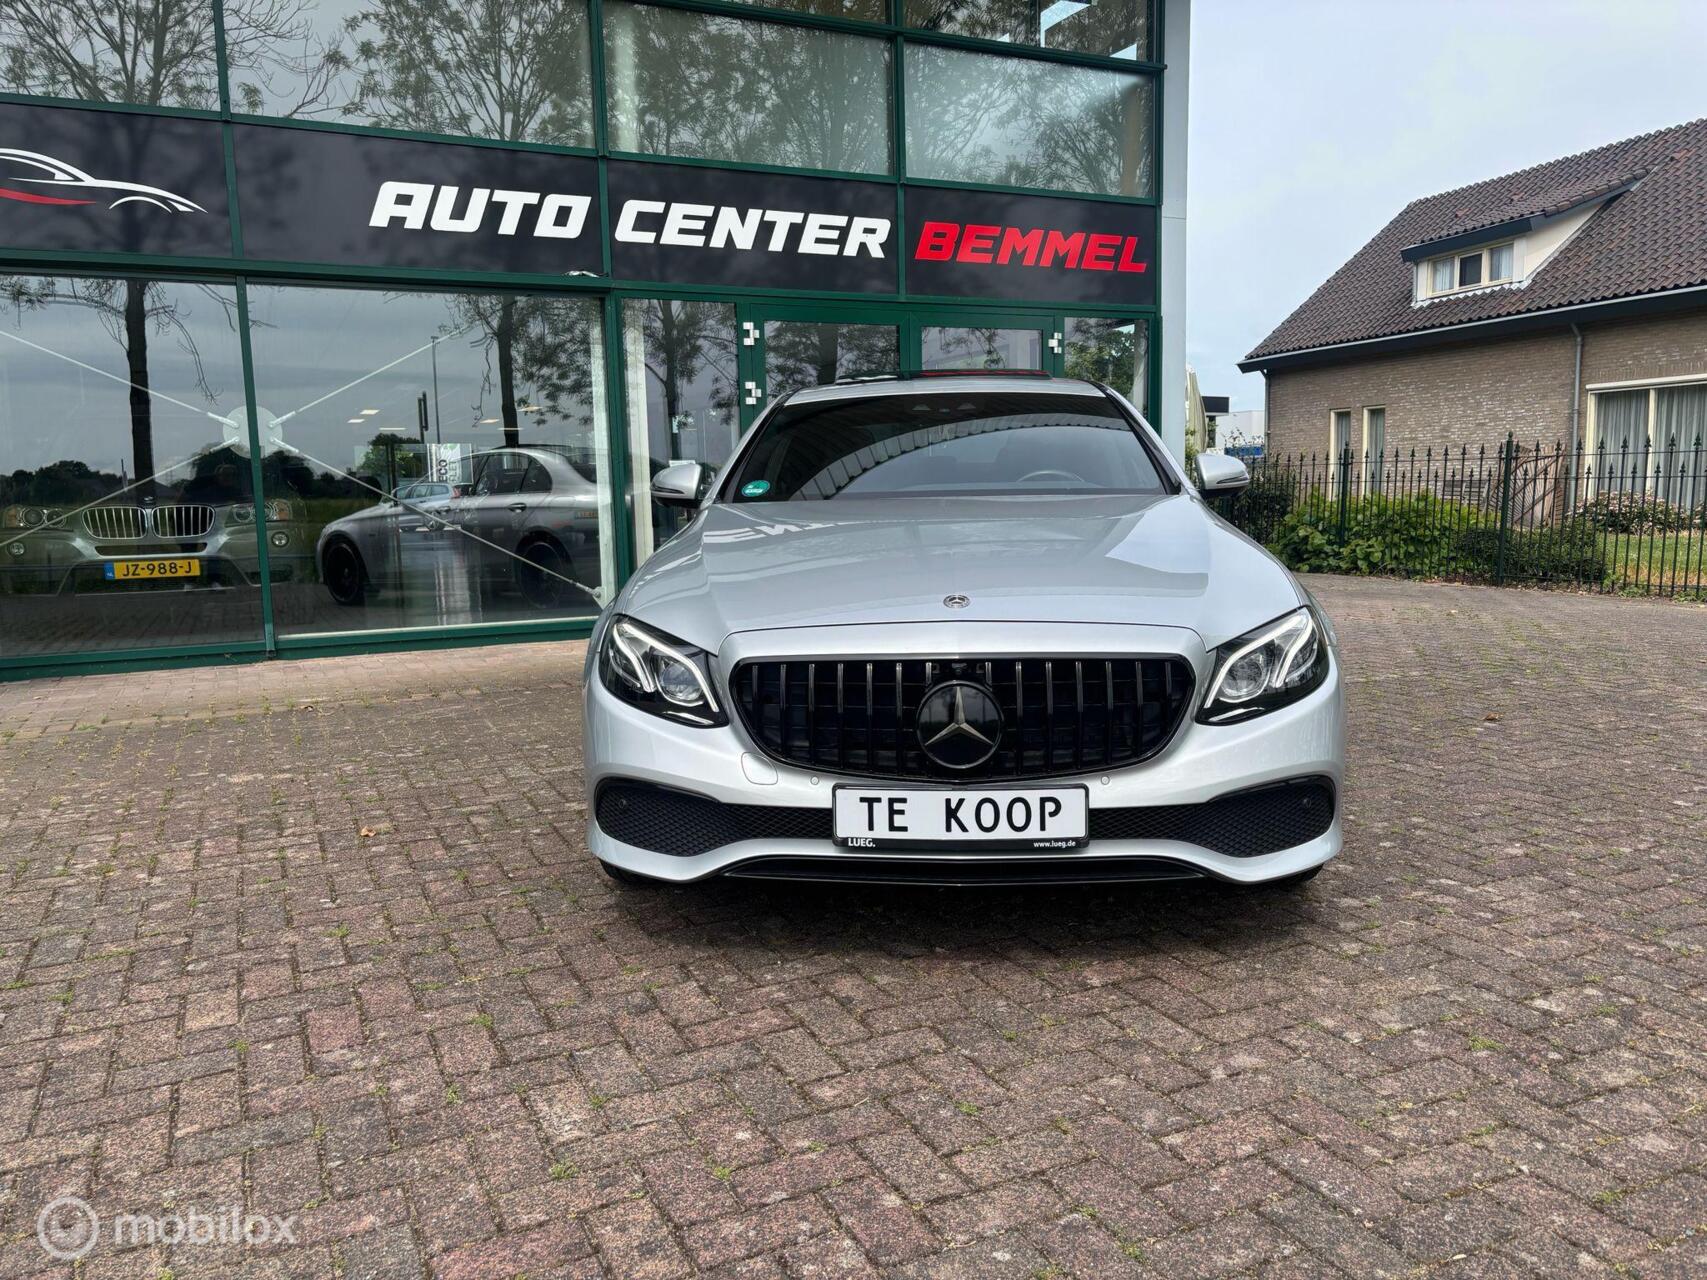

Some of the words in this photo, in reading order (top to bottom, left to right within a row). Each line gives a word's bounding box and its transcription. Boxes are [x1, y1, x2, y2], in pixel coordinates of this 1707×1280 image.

[368, 180, 592, 239] AUTO
[614, 199, 892, 258] CENTER
[914, 221, 1147, 273] BEMMEL
[122, 561, 192, 577] JZ-988-J
[859, 797, 909, 832] TE
[945, 796, 1062, 833] KOOP
[848, 838, 876, 848] LUEG.
[1033, 839, 1077, 848] www.lueg.de
